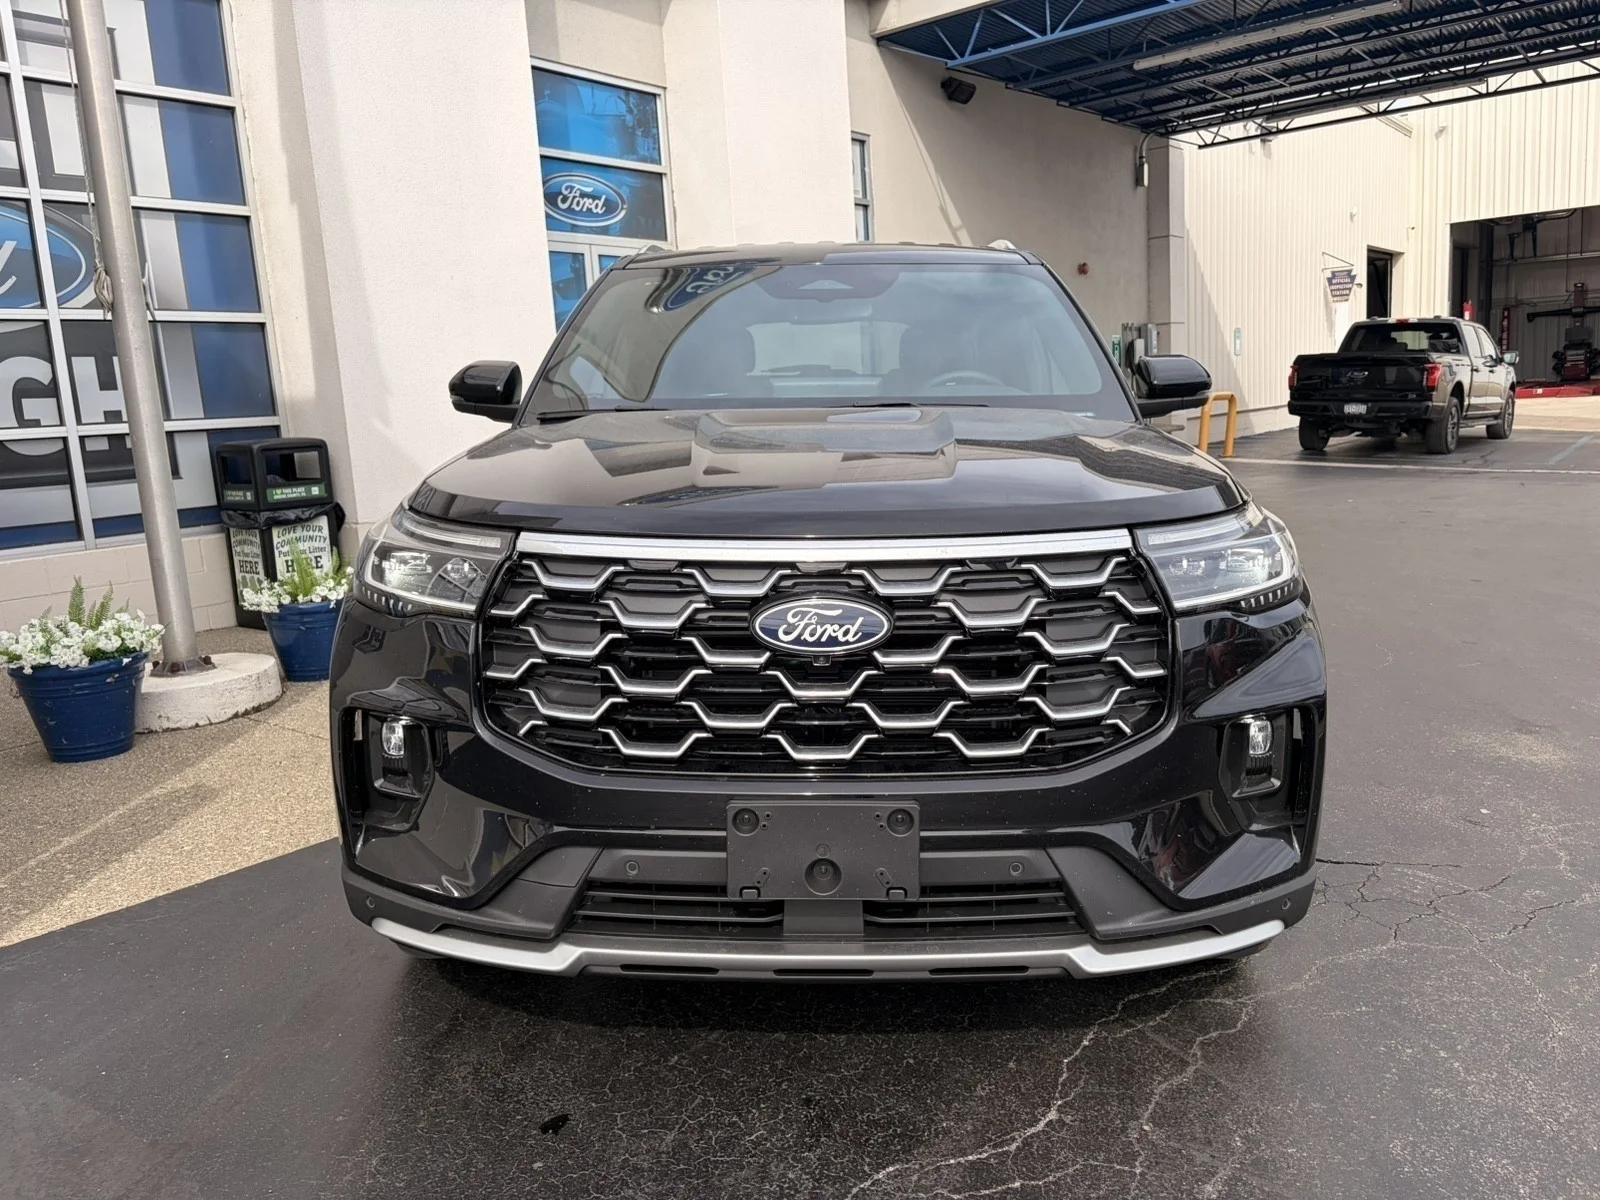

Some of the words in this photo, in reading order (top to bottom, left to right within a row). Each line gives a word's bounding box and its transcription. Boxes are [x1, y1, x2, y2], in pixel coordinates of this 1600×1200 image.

[557, 182, 606, 214] Ford
[233, 529, 245, 538] LOVE
[245, 529, 258, 539] YOUR
[277, 525, 298, 539] LOVE
[301, 524, 323, 534] YOUR
[232, 539, 260, 550] COMMUNITY
[278, 550, 290, 558] Put
[308, 546, 327, 554] Litter
[239, 560, 260, 575] HERE
[285, 555, 324, 574] HE
[778, 607, 865, 642] Ford
